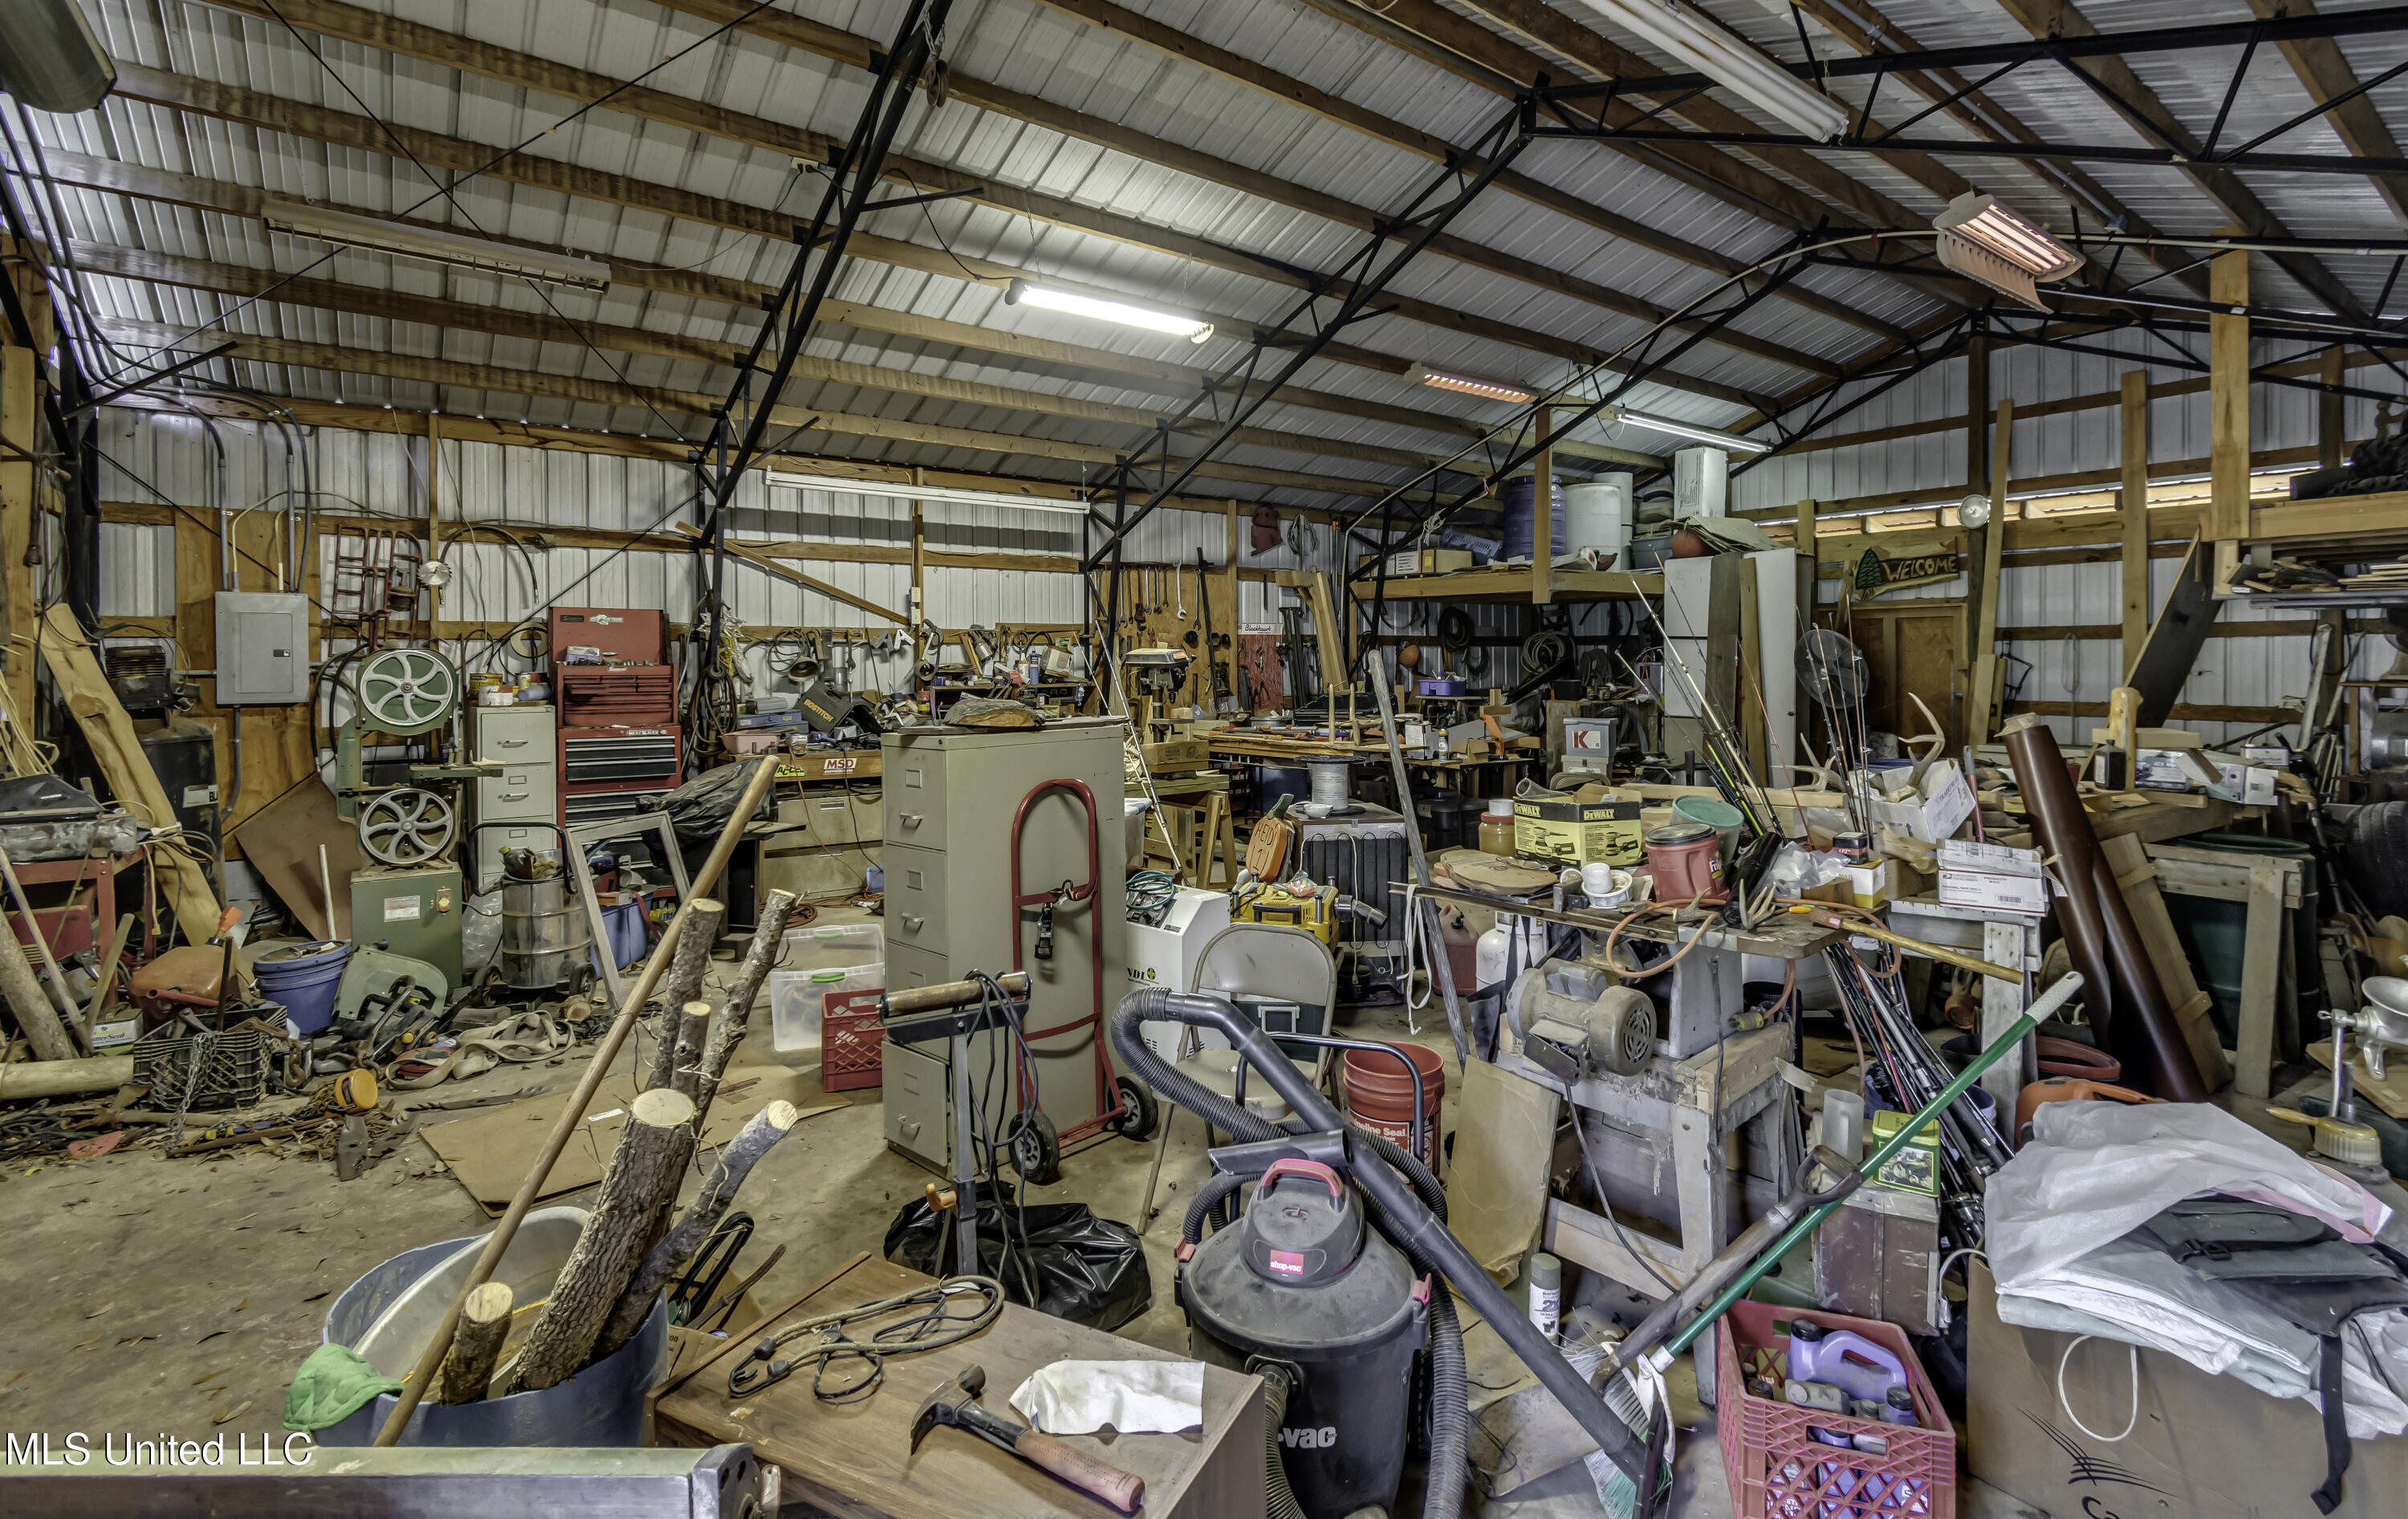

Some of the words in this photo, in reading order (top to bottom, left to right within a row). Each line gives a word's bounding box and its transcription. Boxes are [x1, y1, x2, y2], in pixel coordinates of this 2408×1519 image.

[1881, 556, 1959, 582] WELCOME
[1245, 623, 1271, 632] Blackhawk
[803, 698, 835, 722] BOSTITCH
[827, 759, 854, 769] MSD
[1584, 810, 1614, 820] DEWALT
[1255, 822, 1279, 848] HEIDI
[1383, 1127, 1406, 1136] Seal
